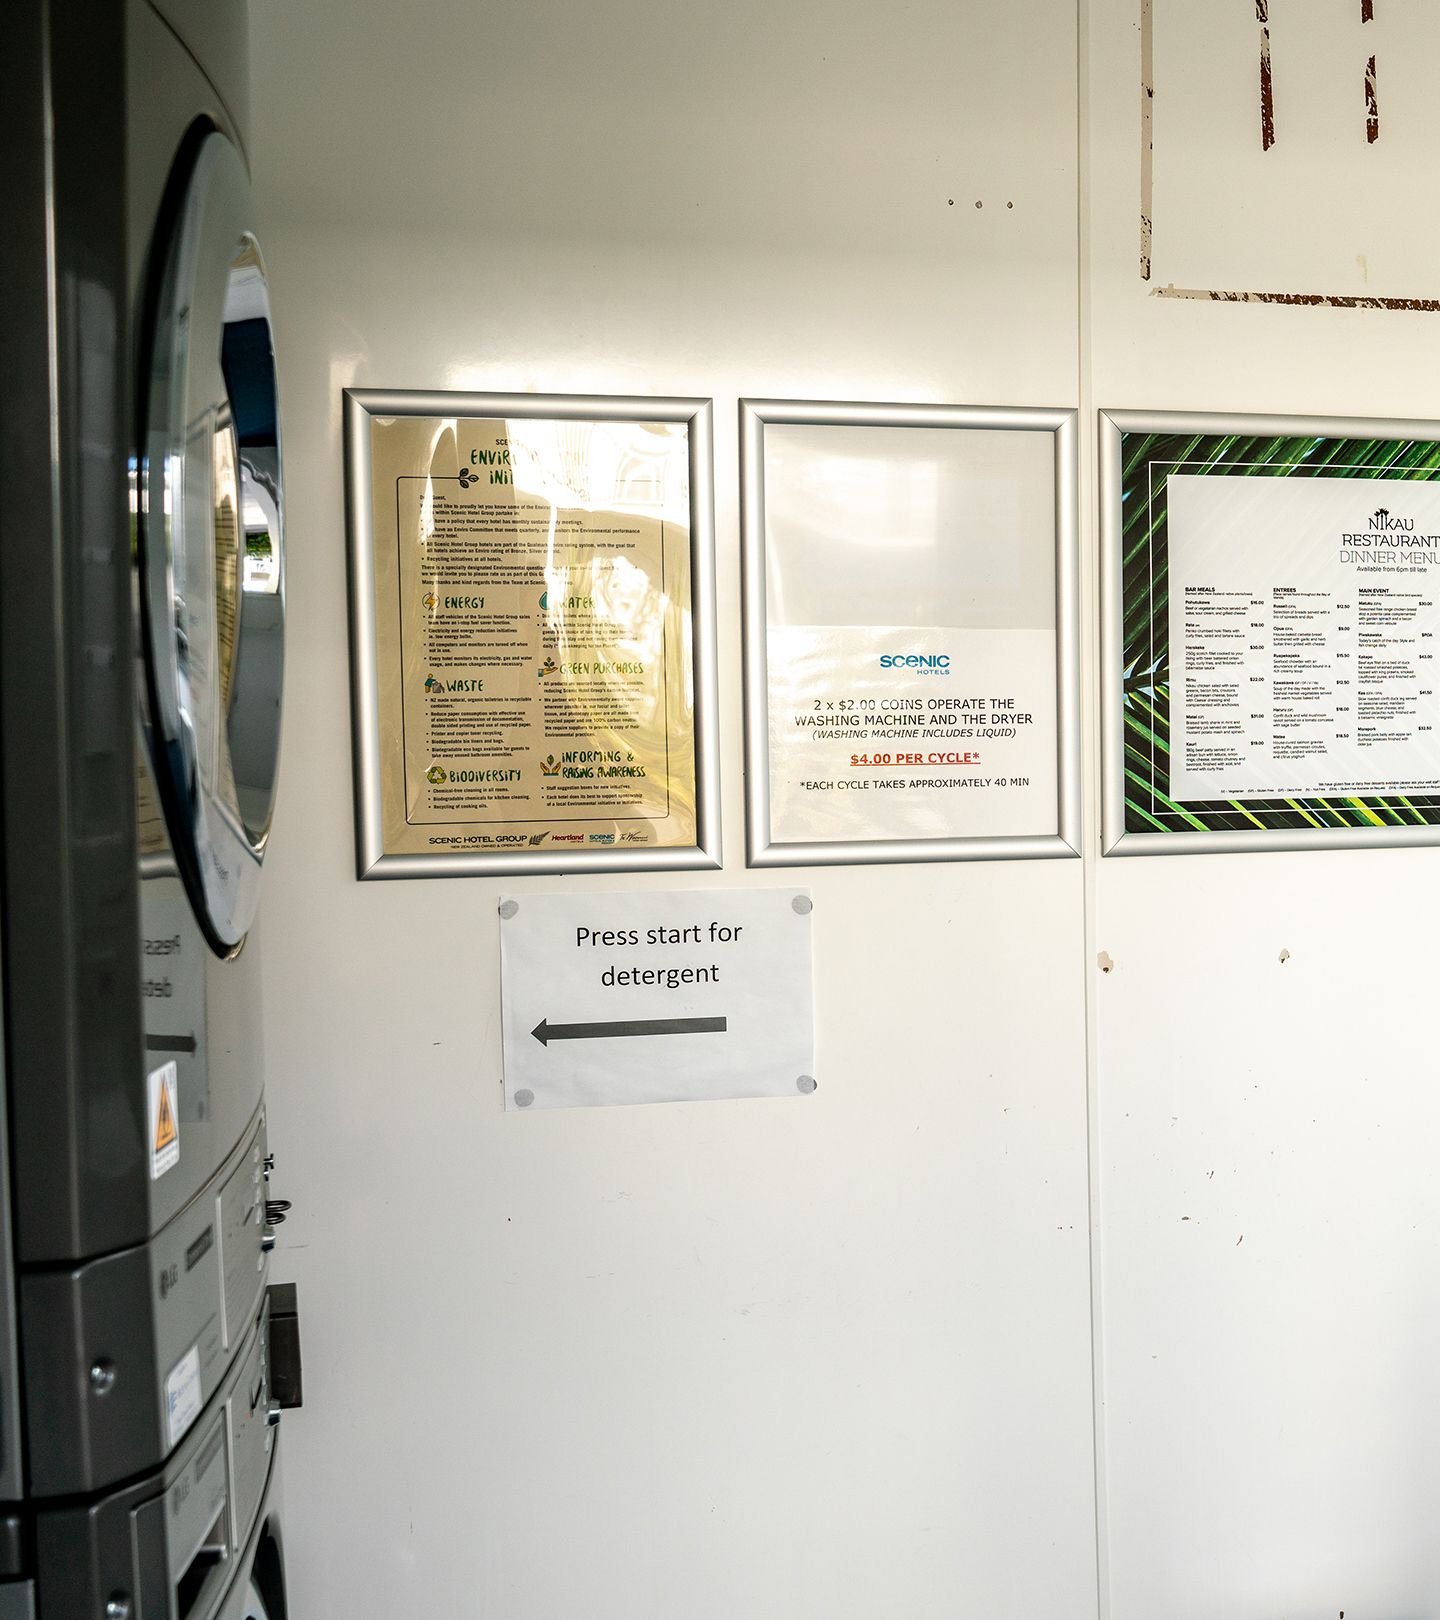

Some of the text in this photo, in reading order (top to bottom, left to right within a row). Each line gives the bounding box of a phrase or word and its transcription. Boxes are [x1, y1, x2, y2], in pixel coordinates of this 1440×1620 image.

[1368, 513, 1413, 530] NIKAU
[1342, 534, 1440, 547] RESTAURANT
[1340, 550, 1396, 563] DINNER
[444, 596, 484, 608] ENERGY
[560, 662, 643, 674] GREEN PURCHASES
[446, 679, 483, 691] WASTE
[814, 698, 1013, 711] 2 x $2.00 COINS OPERATE THE
[795, 713, 1033, 727] WASHING MACHINE AND THE DRYER
[812, 728, 1015, 739] (WASHING MACHINE INCLUDES LIQUID)
[626, 752, 633, 761] &
[850, 754, 891, 766] $4.00
[896, 754, 924, 764] PER
[597, 765, 645, 777] AWARENESS
[837, 780, 868, 789] CYCLE
[872, 779, 905, 788] TAKES
[908, 778, 991, 787] APPROXIMATELY
[994, 778, 1006, 786] 40
[1010, 777, 1028, 786] MIN
[429, 836, 461, 844] SCENIC
[463, 835, 494, 843] HOTEL
[577, 922, 743, 947] Press start for
[601, 964, 720, 988] detergent
